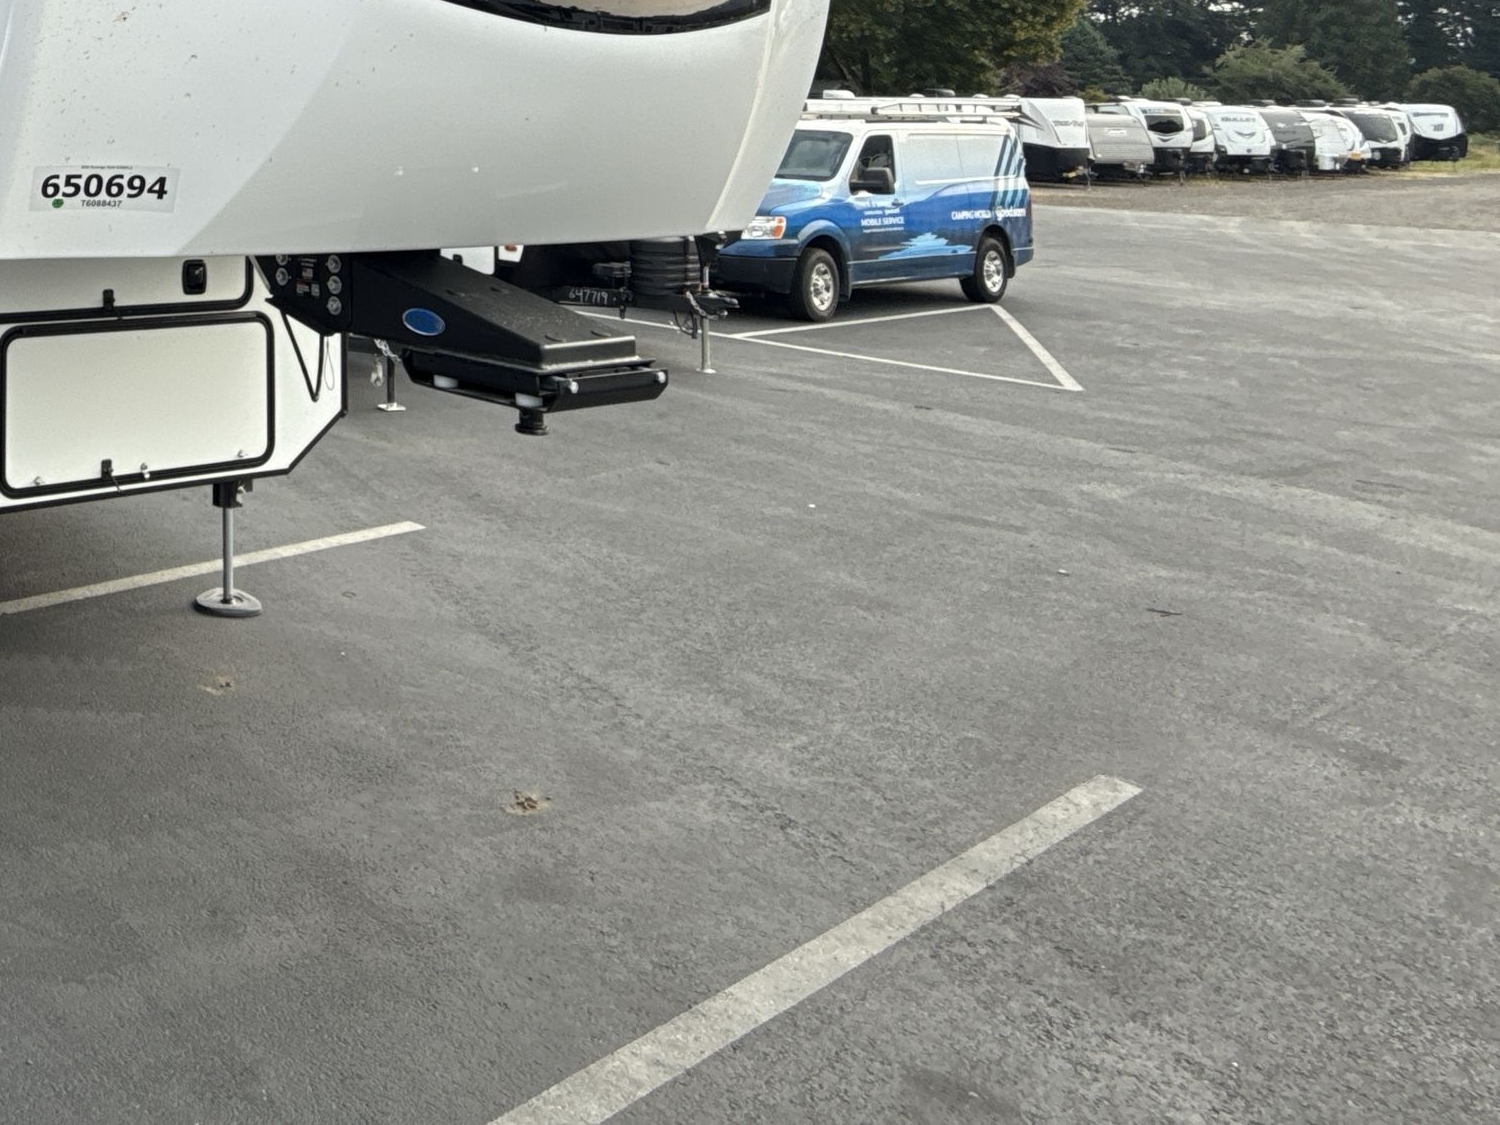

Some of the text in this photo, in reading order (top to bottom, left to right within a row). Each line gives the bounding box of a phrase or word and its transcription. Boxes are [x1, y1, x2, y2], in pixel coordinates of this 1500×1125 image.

[41, 173, 168, 200] 650694
[80, 199, 123, 208] T6088437
[882, 215, 905, 225] SERVICE
[569, 287, 609, 305] 647719
